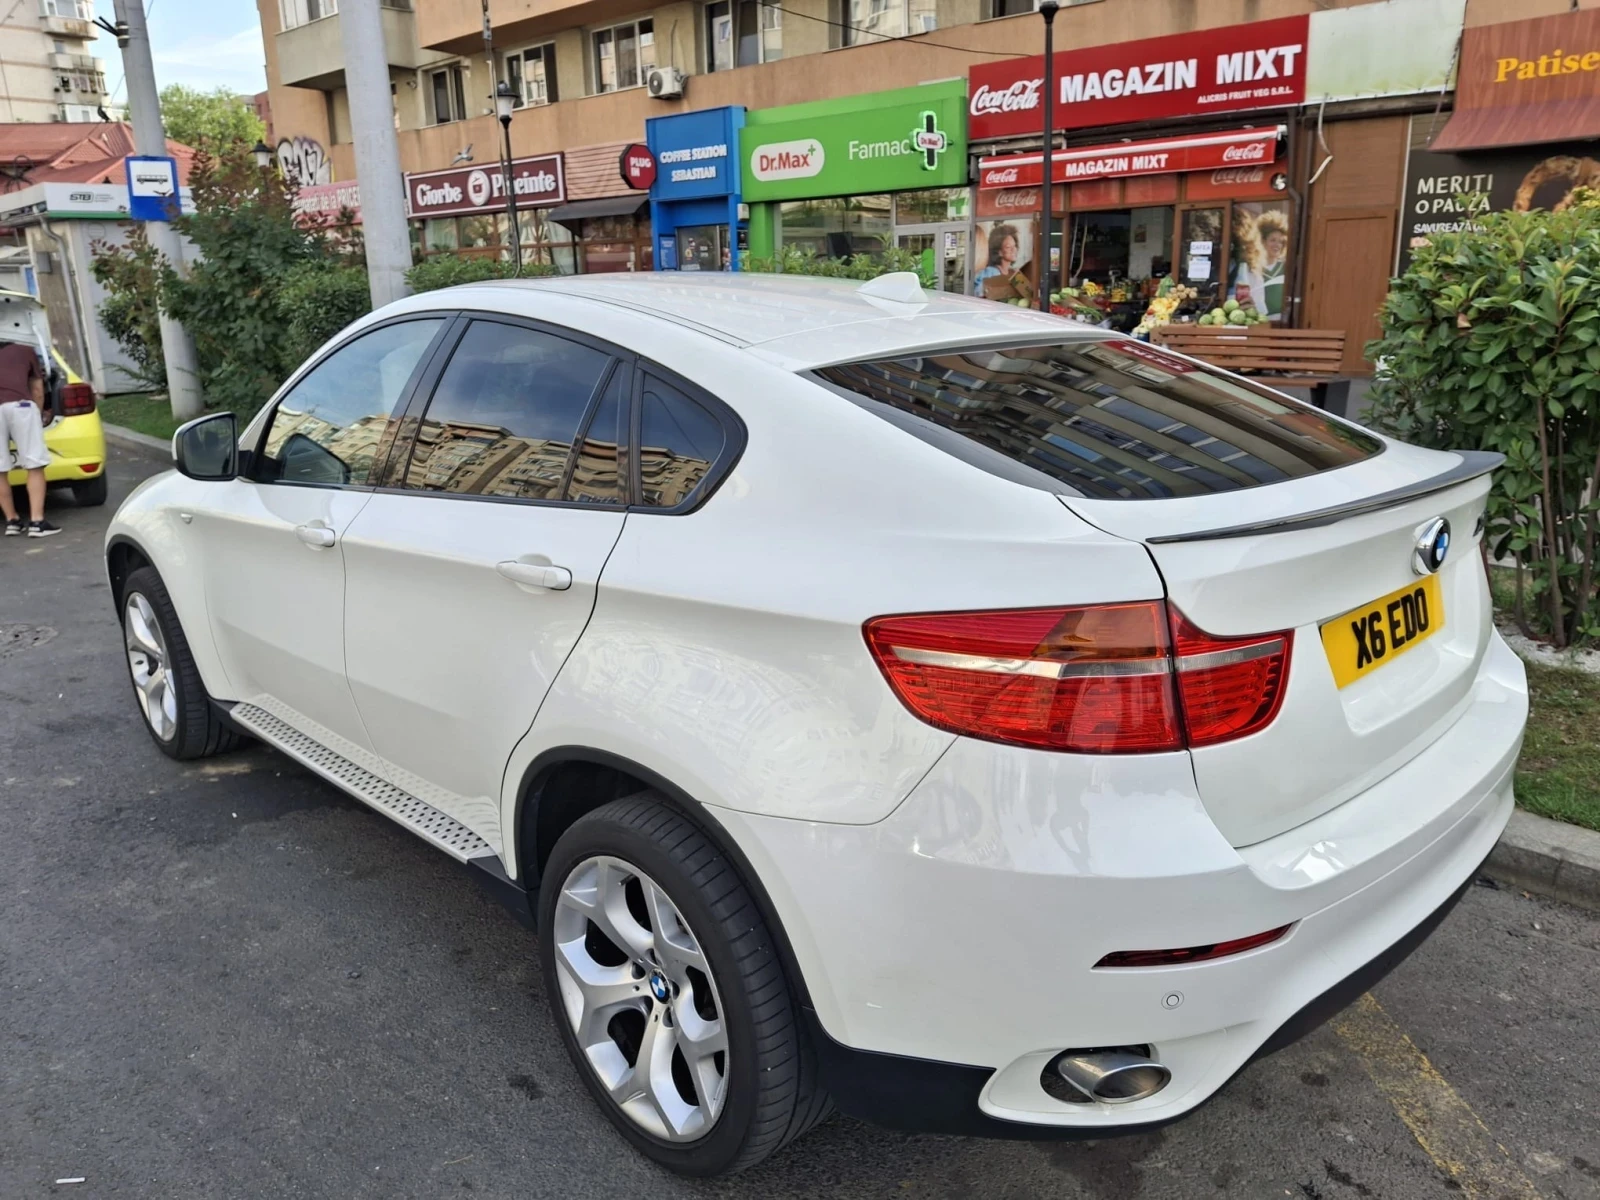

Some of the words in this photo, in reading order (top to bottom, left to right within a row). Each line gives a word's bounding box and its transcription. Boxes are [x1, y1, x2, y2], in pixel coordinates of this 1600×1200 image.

[1060, 58, 1198, 104] MAGAZIN
[1215, 44, 1303, 85] MIXT
[1494, 49, 1600, 83] Patise
[970, 78, 1045, 116] Coca-Cola
[1228, 89, 1252, 100] FRUIT
[1253, 87, 1269, 97] VEG
[660, 148, 692, 164] COFFEE
[692, 144, 727, 160] STATION
[849, 138, 915, 160] Farmac
[630, 167, 641, 177] IN
[671, 166, 716, 182] SEBASTIAN
[1065, 157, 1129, 177] MAGAZIN
[1132, 153, 1169, 170] MIXT
[69, 193, 93, 201] STB
[416, 183, 463, 206] Ciorbe
[1415, 199, 1430, 214] O
[1351, 611, 1386, 669] X6
[1387, 587, 1429, 649] EDO
